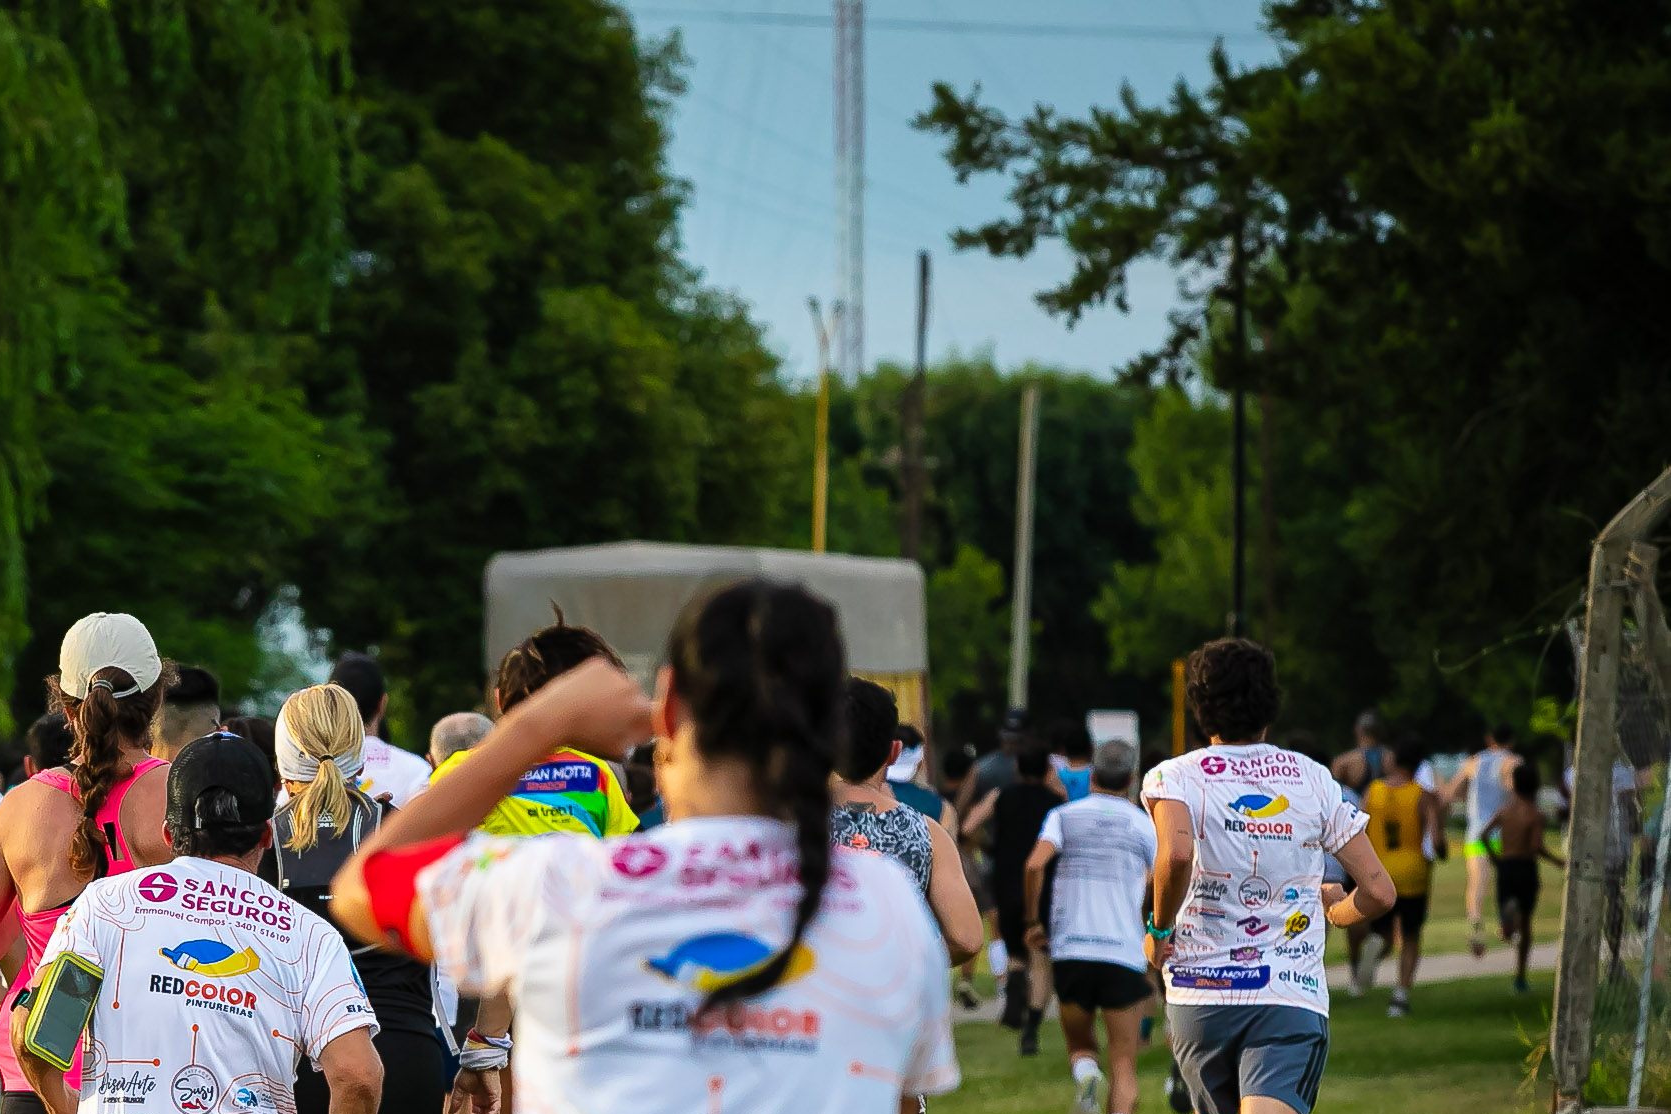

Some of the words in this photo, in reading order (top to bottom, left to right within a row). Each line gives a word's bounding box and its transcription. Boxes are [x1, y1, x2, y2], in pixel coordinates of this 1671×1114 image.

[1224, 819, 1293, 835] REDCOLOR
[181, 893, 292, 931] SEGUROS
[183, 878, 292, 916] SANCOR
[134, 906, 184, 921] Emmanuel
[186, 914, 226, 927] Campos
[235, 920, 257, 932] 3401
[259, 928, 291, 944] 516109
[1278, 969, 1290, 982] el
[149, 974, 257, 1011] REDCOLOR
[185, 998, 253, 1019] PINTURERIAS
[174, 1077, 214, 1101] Susy
